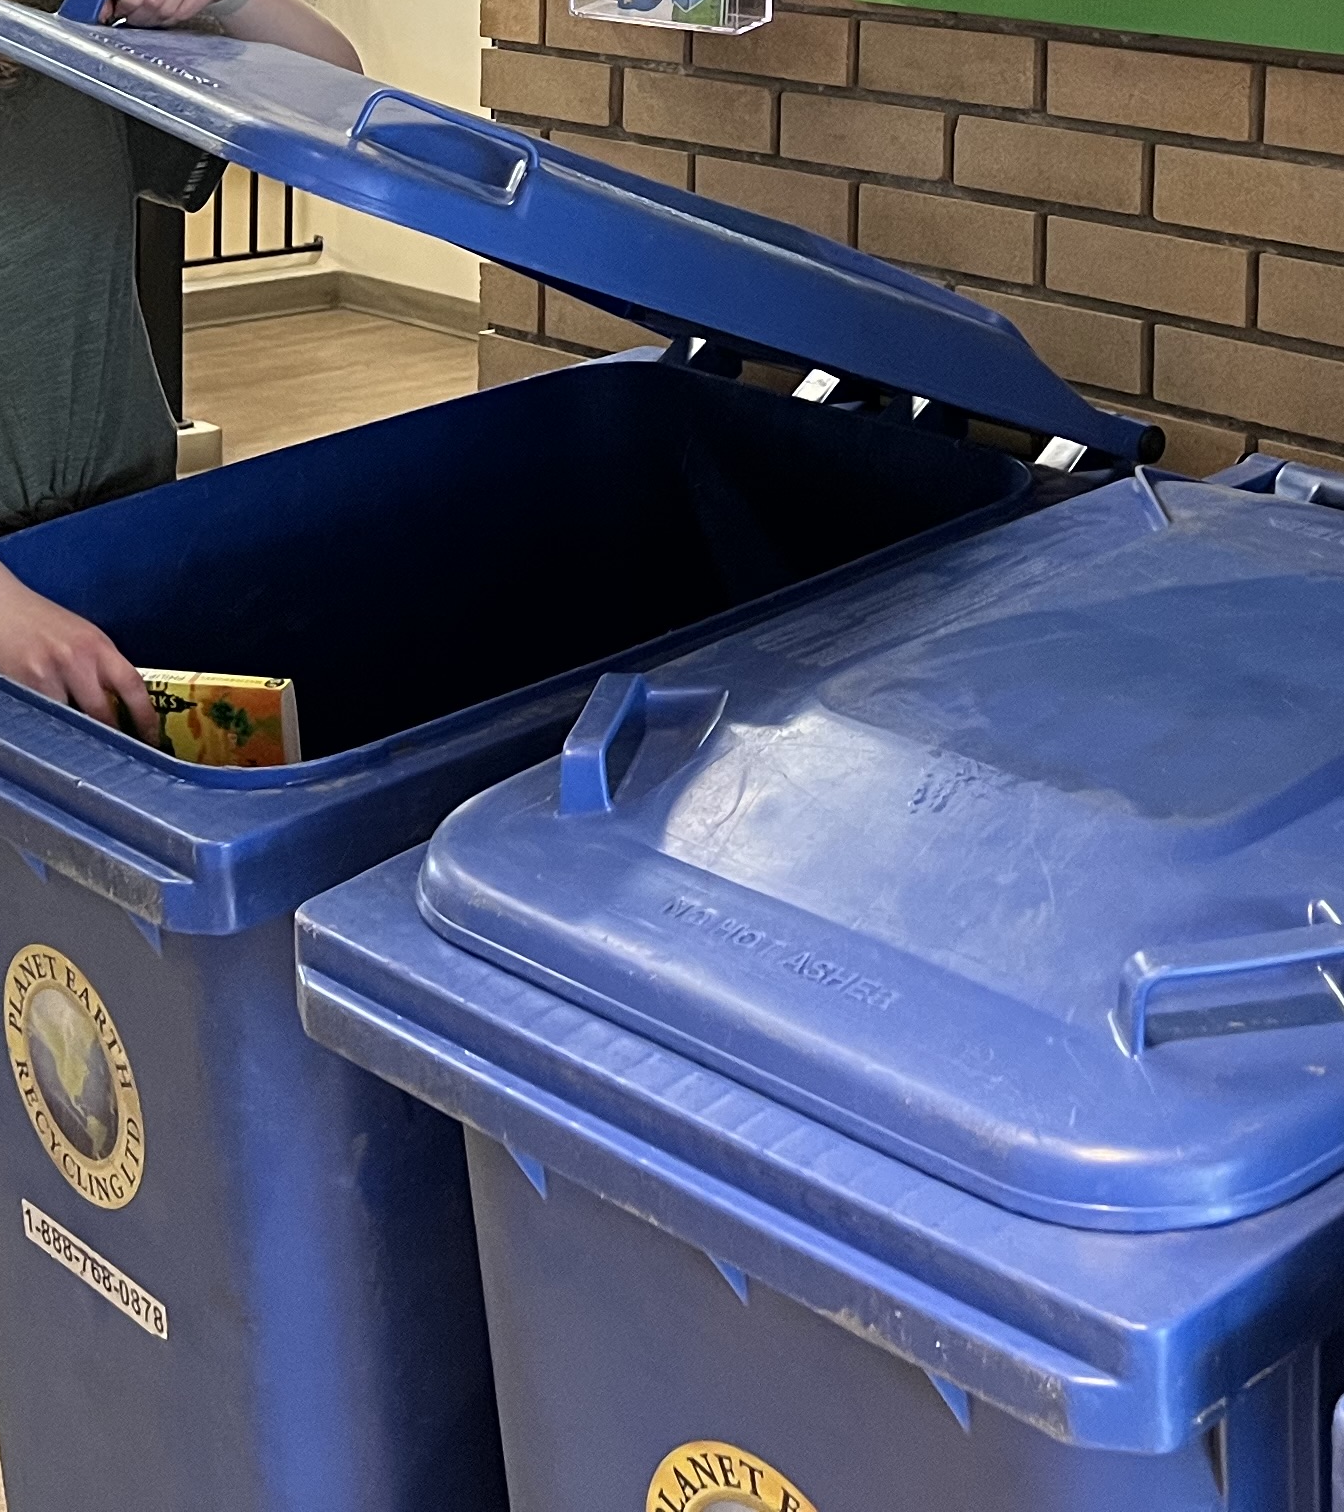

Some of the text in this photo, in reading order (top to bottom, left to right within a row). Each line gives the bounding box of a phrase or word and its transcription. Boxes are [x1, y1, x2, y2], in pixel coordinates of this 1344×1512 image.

[8, 954, 134, 1091] PLANET EARTH
[712, 916, 788, 960] HOT
[782, 949, 901, 1012] ASHES
[15, 1059, 142, 1203] RECYCLING LTD
[24, 1207, 166, 1335] 1-888-768-0878
[654, 1452, 765, 1512] LANET
